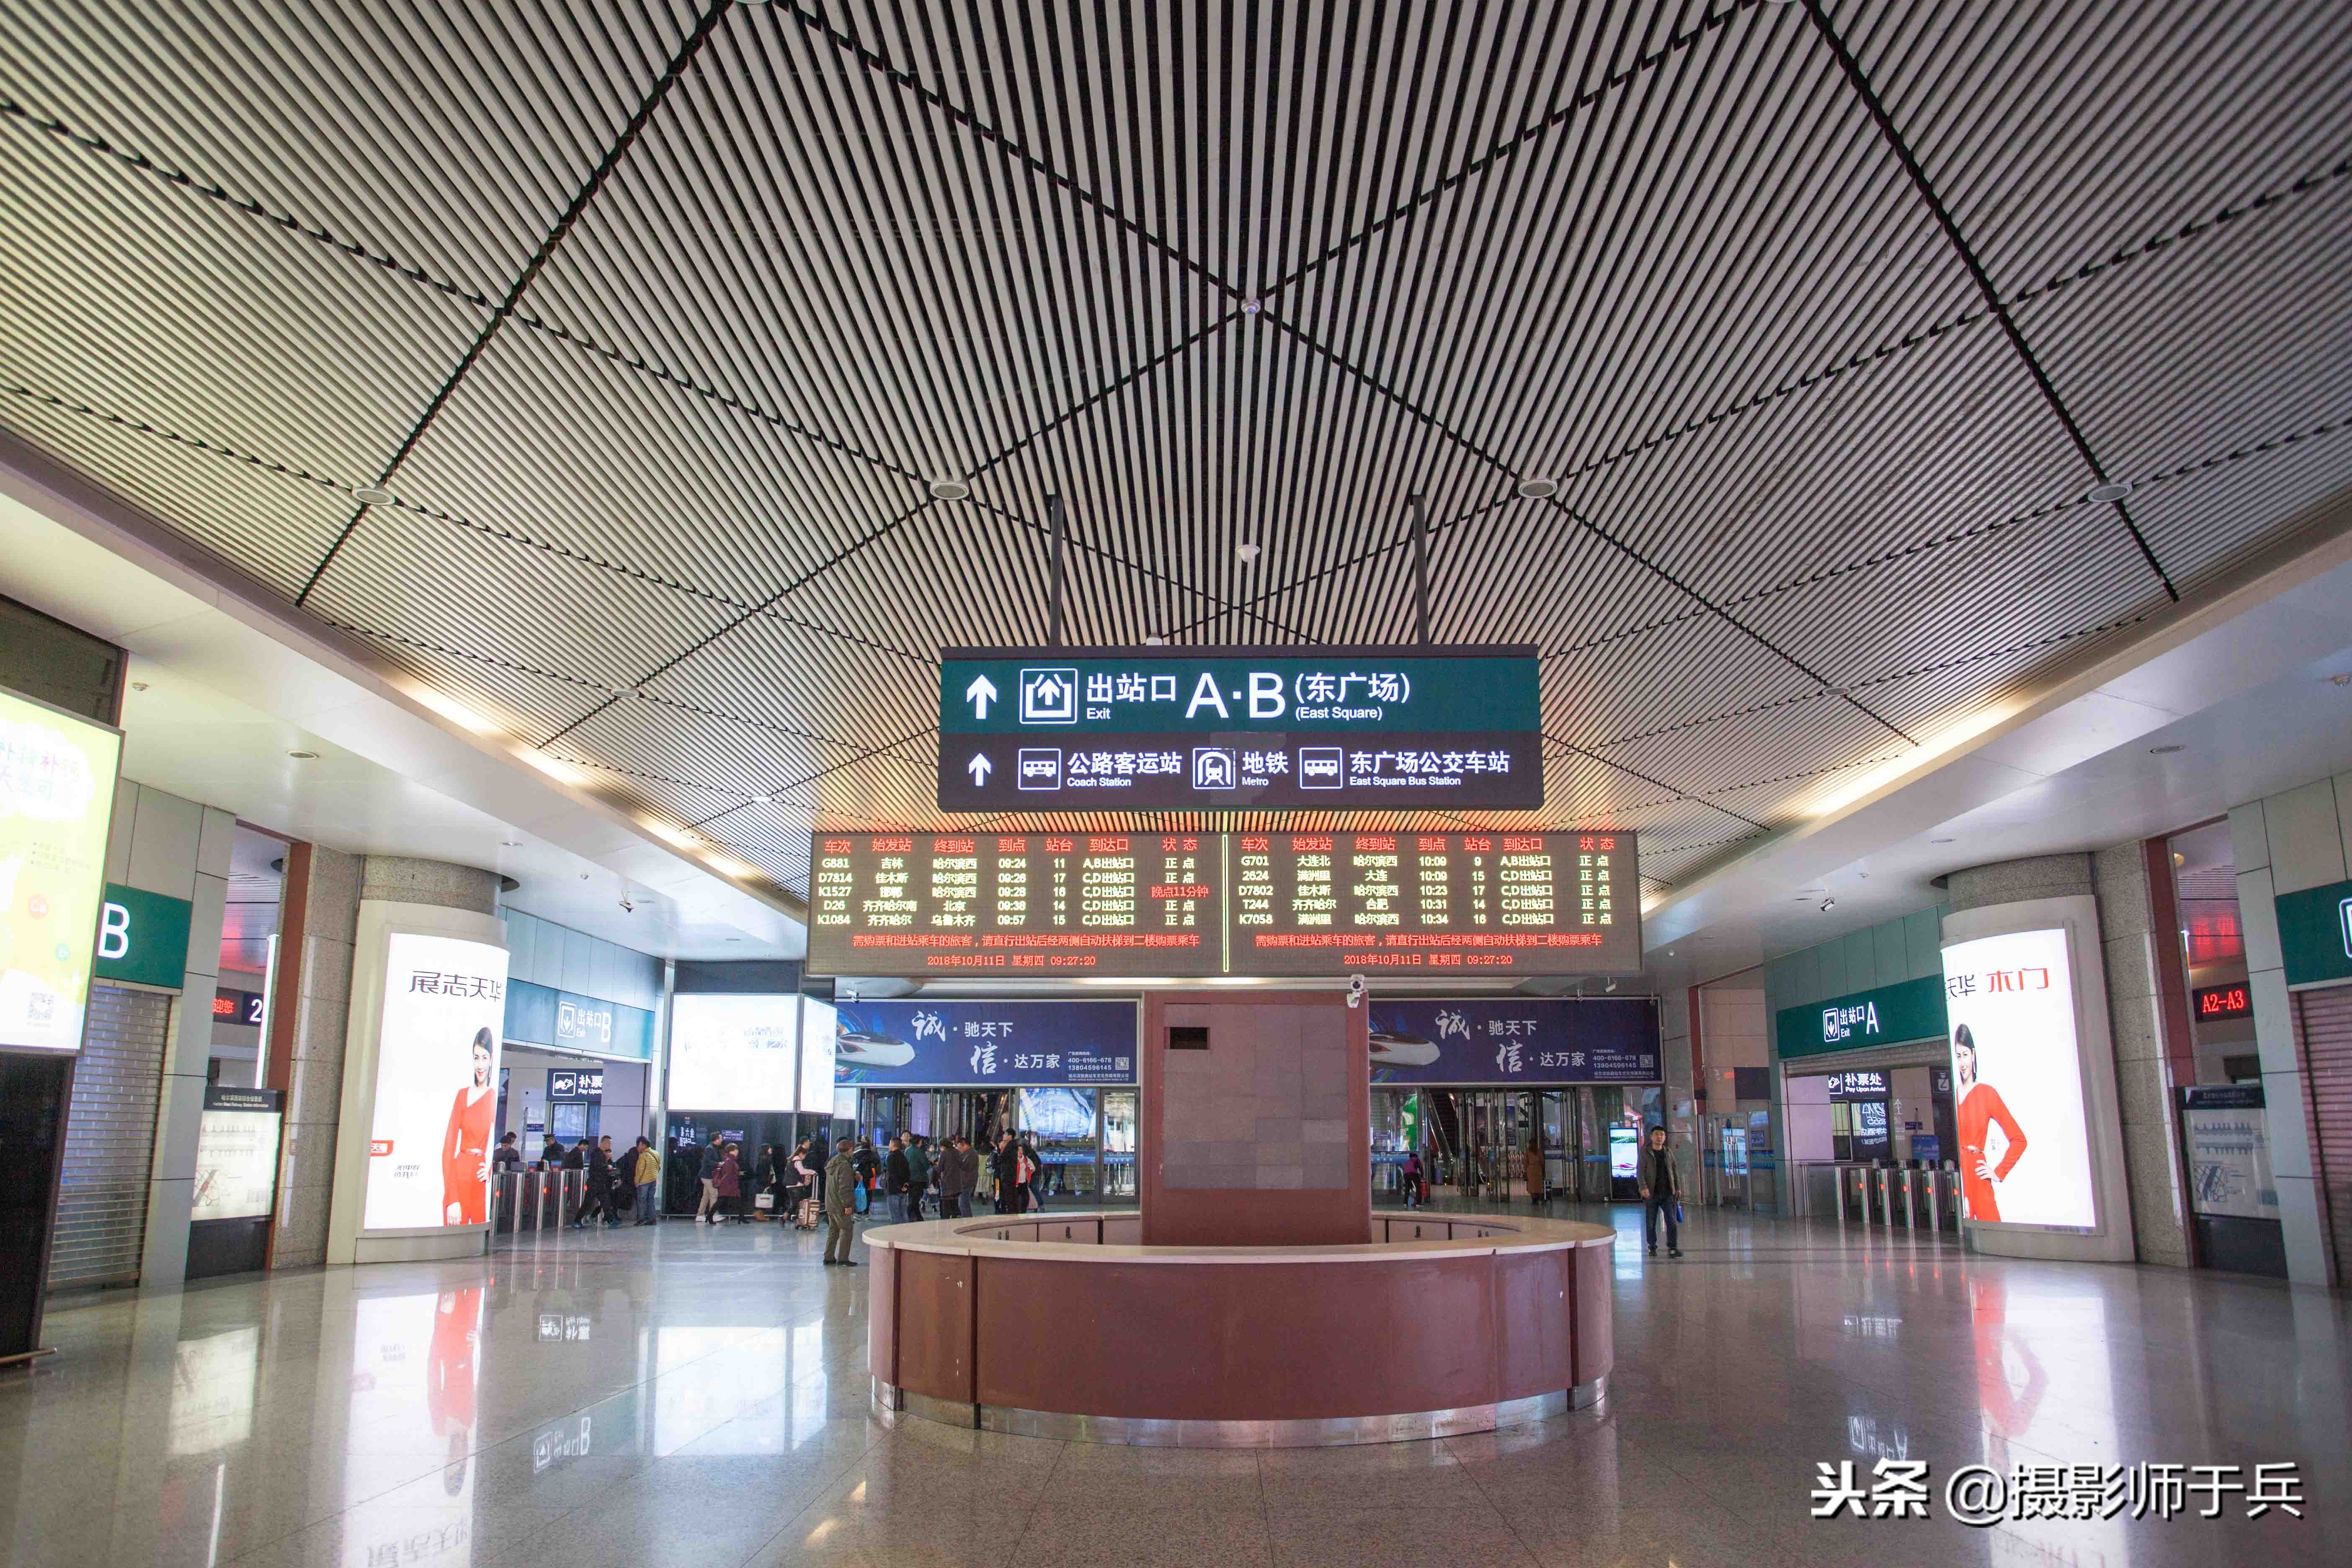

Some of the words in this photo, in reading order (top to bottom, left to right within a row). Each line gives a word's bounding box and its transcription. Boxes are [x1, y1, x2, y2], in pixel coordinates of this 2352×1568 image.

[1087, 675, 1177, 705] 出站口
[1295, 671, 1411, 706] (东广场)
[1087, 707, 1112, 720] Exit
[1295, 706, 1328, 722] (East
[1332, 706, 1383, 722] Square)
[1068, 752, 1182, 775] 公路客运站
[1242, 752, 1288, 774] 地铁
[1350, 751, 1510, 774] 东广场公交车站
[1067, 776, 1096, 787] Coach
[1099, 776, 1132, 787] Station
[1242, 776, 1269, 787] Metro
[1350, 776, 1369, 786] East
[1371, 776, 1406, 787] Square
[1408, 776, 1426, 786] Bus
[1429, 776, 1461, 787] Station
[824, 840, 851, 853] 车次
[872, 839, 911, 852] 始发站
[934, 839, 974, 853] 终到站
[998, 838, 1025, 851] 到点
[1046, 838, 1073, 851] 站台
[1089, 838, 1129, 851] 到达口
[1242, 838, 1268, 851] 车次
[1292, 838, 1332, 851] 始发站
[1355, 838, 1395, 851] 终到站
[1418, 838, 1445, 851] 到点
[1464, 838, 1491, 851] 站台
[1504, 838, 1542, 851] 到达口
[822, 858, 849, 868] G881
[881, 858, 904, 869] 吉林
[933, 858, 977, 869] 哈尔滨西
[998, 858, 1026, 868] 09:24
[1053, 858, 1065, 868] 11
[1241, 856, 1269, 866] G701
[1297, 856, 1330, 867] 大连北
[1353, 856, 1397, 867] 哈尔滨西
[1419, 856, 1447, 866] 10:09
[818, 873, 853, 883] D7814
[875, 872, 908, 884] 佳木斯
[932, 872, 977, 884] 哈尔滨西
[998, 873, 1026, 883] 09:26
[1053, 873, 1066, 883] 17
[1243, 871, 1269, 880] 2624
[1297, 870, 1331, 882] 满洲里
[1365, 870, 1387, 882] 大连
[1420, 871, 1447, 881] 10:09
[1473, 871, 1485, 881] 15
[818, 887, 851, 897] K1527
[932, 887, 976, 898] 哈尔滨西
[998, 887, 1026, 897] 09:28
[1053, 887, 1066, 897] 16
[1151, 885, 1208, 898] 晚点11分钟
[1239, 885, 1273, 896] D7802
[1298, 885, 1331, 896] 佳木斯
[1354, 885, 1398, 897] 哈尔滨西
[1420, 885, 1447, 895] 10:23
[1473, 886, 1485, 896] 17
[824, 900, 846, 910] D26
[943, 900, 966, 911] 北京
[998, 901, 1026, 911] 09:38
[1053, 901, 1065, 910] 14
[1243, 899, 1269, 909] T244
[1292, 899, 1336, 910] 齐齐哈尔
[1366, 899, 1388, 910] 合肥
[1421, 899, 1447, 909] 10:31
[1473, 900, 1485, 909] 14
[817, 914, 851, 925] K1084
[867, 914, 911, 926] 齐齐哈尔
[931, 915, 975, 926] 乌鲁木齐
[998, 915, 1026, 925] 09:57
[1053, 915, 1065, 925] 15
[1239, 914, 1273, 924] K7058
[1298, 914, 1332, 925] 满洲里
[1354, 914, 1399, 925] 哈尔滨西
[1421, 914, 1448, 924] 10:34
[1474, 914, 1486, 924] 16
[97, 902, 130, 959] B
[928, 955, 1004, 966] 2018年10月11日
[1011, 955, 1044, 966] 星期四
[1050, 956, 1096, 966] 09:27:20
[1344, 954, 1421, 965] 2018年10月11日
[1429, 954, 1460, 965] 星期四
[1468, 956, 1512, 965] 09:27:20
[409, 971, 502, 1002] 展志天华
[1986, 968, 2049, 992] 木门
[2202, 989, 2245, 1013] A2-A3
[249, 999, 263, 1022] 2
[1840, 1006, 1864, 1025] 出站口
[1866, 1001, 1879, 1034] A
[577, 1008, 601, 1027] 出站口
[601, 1012, 611, 1042] B
[1841, 1028, 1850, 1037] Exit
[1845, 1073, 1882, 1086] 补票处
